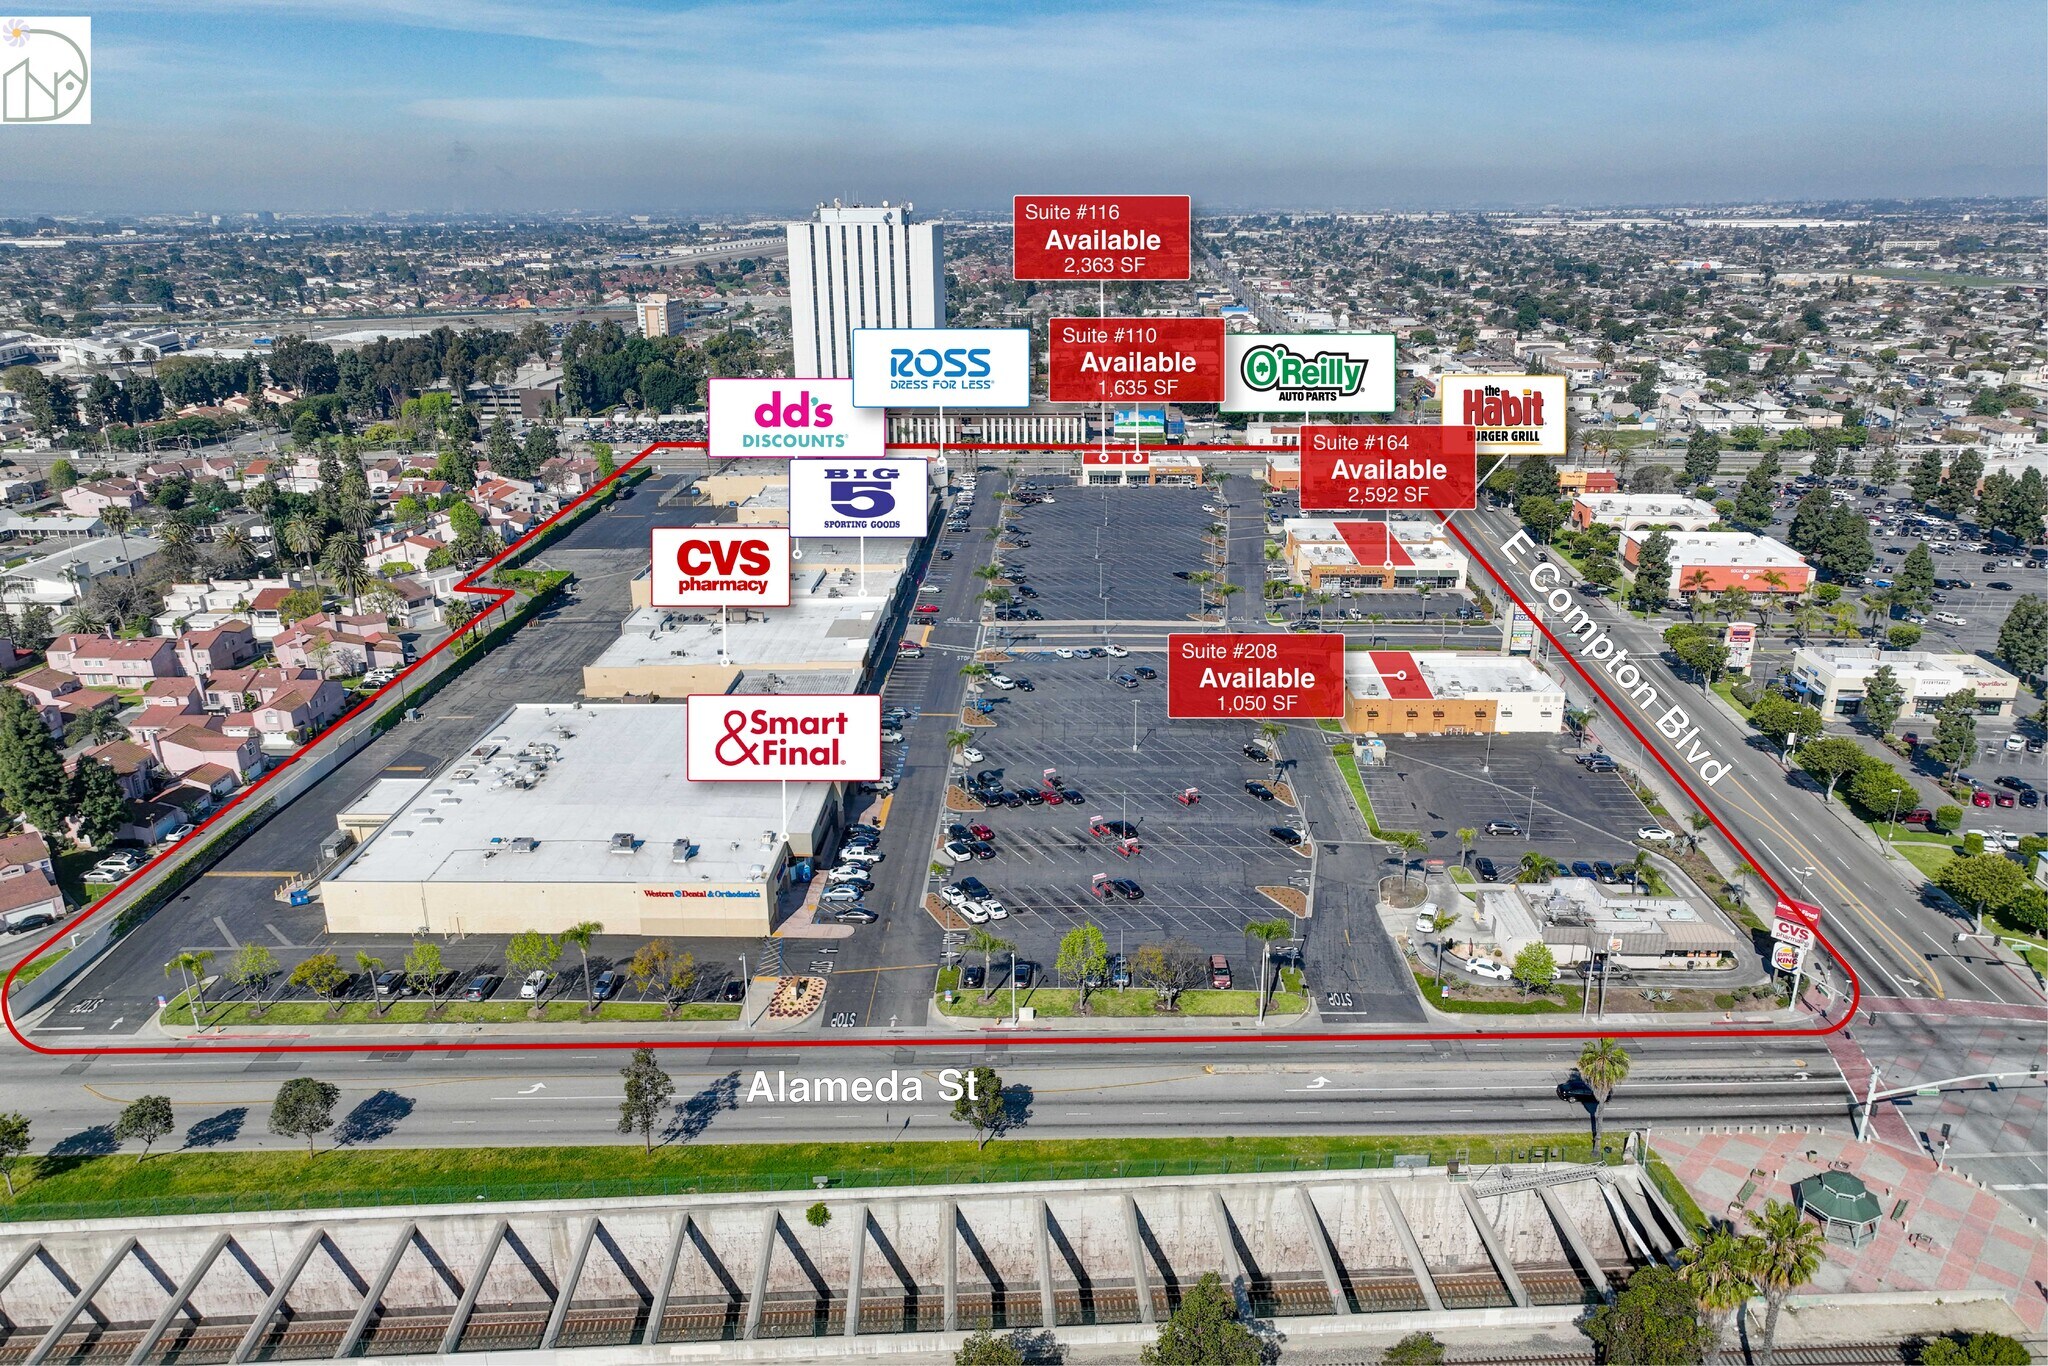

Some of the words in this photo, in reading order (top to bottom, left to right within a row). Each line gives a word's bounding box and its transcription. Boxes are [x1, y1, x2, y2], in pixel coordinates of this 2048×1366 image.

[644, 890, 674, 898] Western
[682, 890, 706, 898] Dental
[708, 890, 714, 898] &
[715, 890, 760, 898] Orthodontics
[1778, 922, 1809, 941] CVS
[1777, 957, 1798, 965] KING
[69, 999, 104, 1013] STOP
[1328, 992, 1353, 1007] STOP
[831, 1012, 857, 1027] STOP
